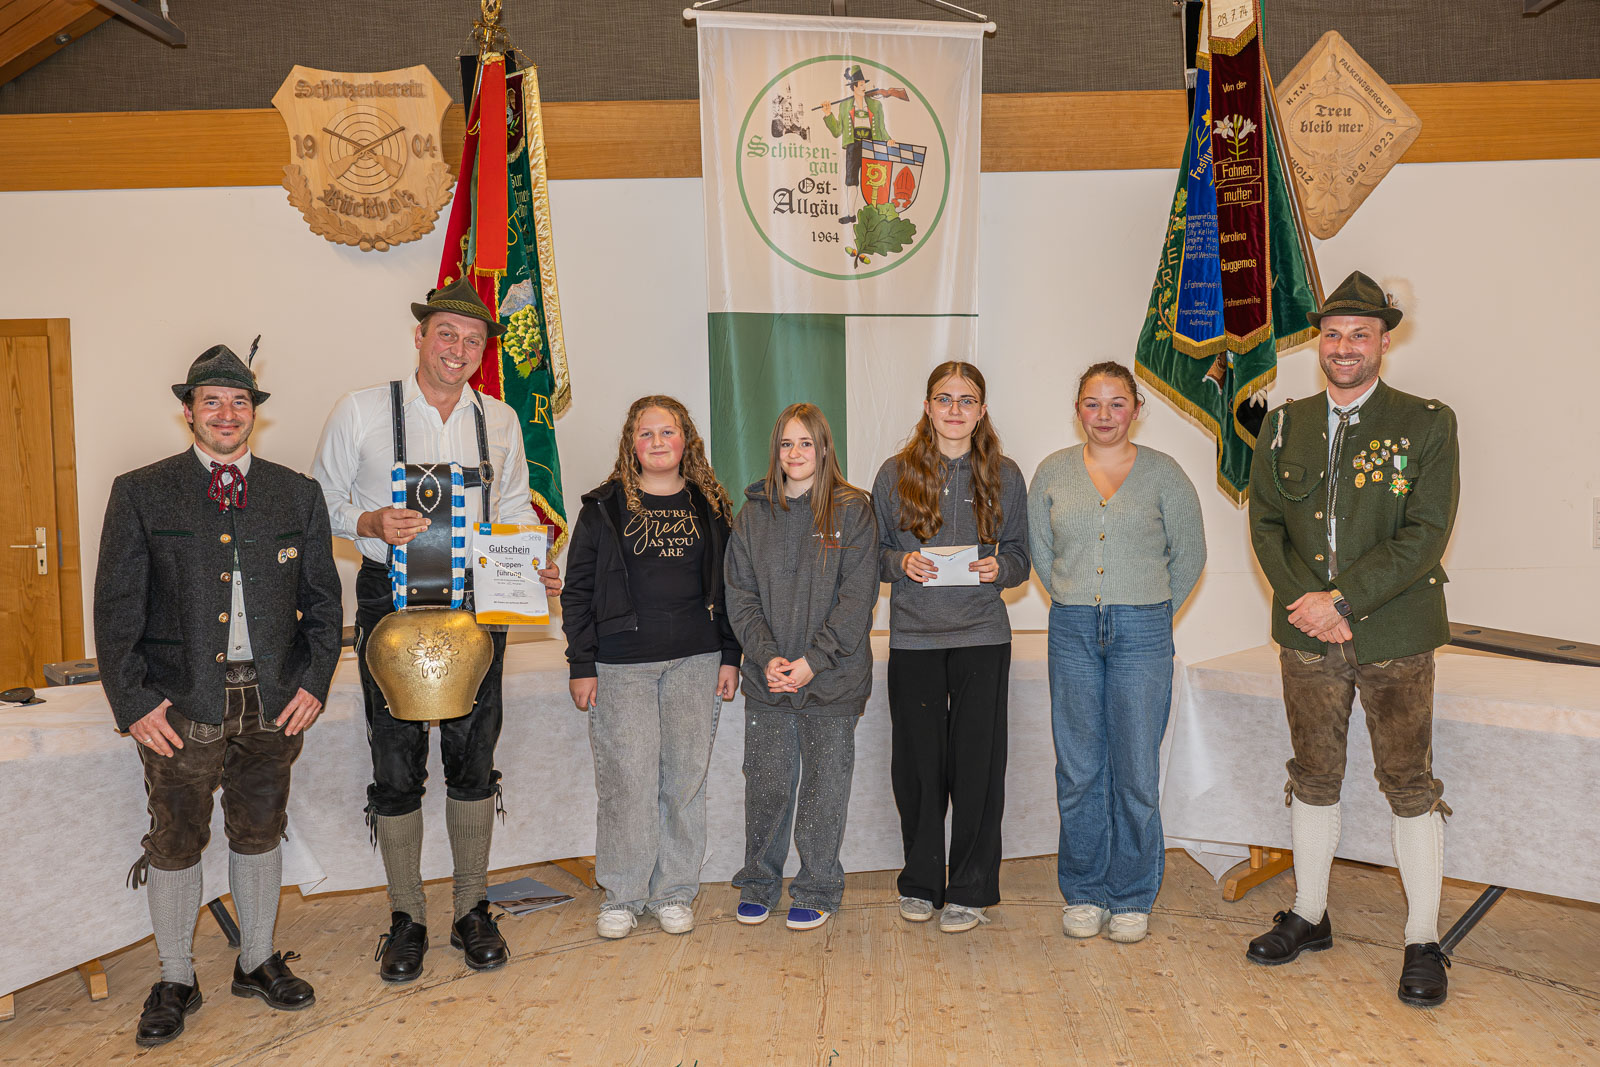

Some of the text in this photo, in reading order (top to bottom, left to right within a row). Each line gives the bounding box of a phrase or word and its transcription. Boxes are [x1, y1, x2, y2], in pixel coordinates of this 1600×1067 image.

[294, 78, 427, 102] Schützenverein
[1222, 80, 1247, 93] Von der
[1286, 82, 1310, 106] H.T.V.
[1338, 57, 1393, 116] FALKENSBERGLER
[1314, 104, 1352, 117] Treu
[1300, 120, 1364, 133] bleib mer
[292, 134, 438, 159] 19 04
[747, 135, 837, 160] Schützen-
[1345, 131, 1395, 186] geg. 1923
[809, 161, 838, 176] gau
[1290, 156, 1314, 186] HOLZ
[797, 177, 837, 195] Ost-
[1224, 187, 1253, 202] mutter
[772, 187, 839, 218] Allgäu
[811, 231, 840, 243] 1964
[1220, 231, 1247, 244] Karolina
[1220, 258, 1257, 273] Guggemos
[488, 544, 530, 554] Gutschein
[648, 537, 694, 547] AS YOU
[658, 548, 684, 557] ARE
